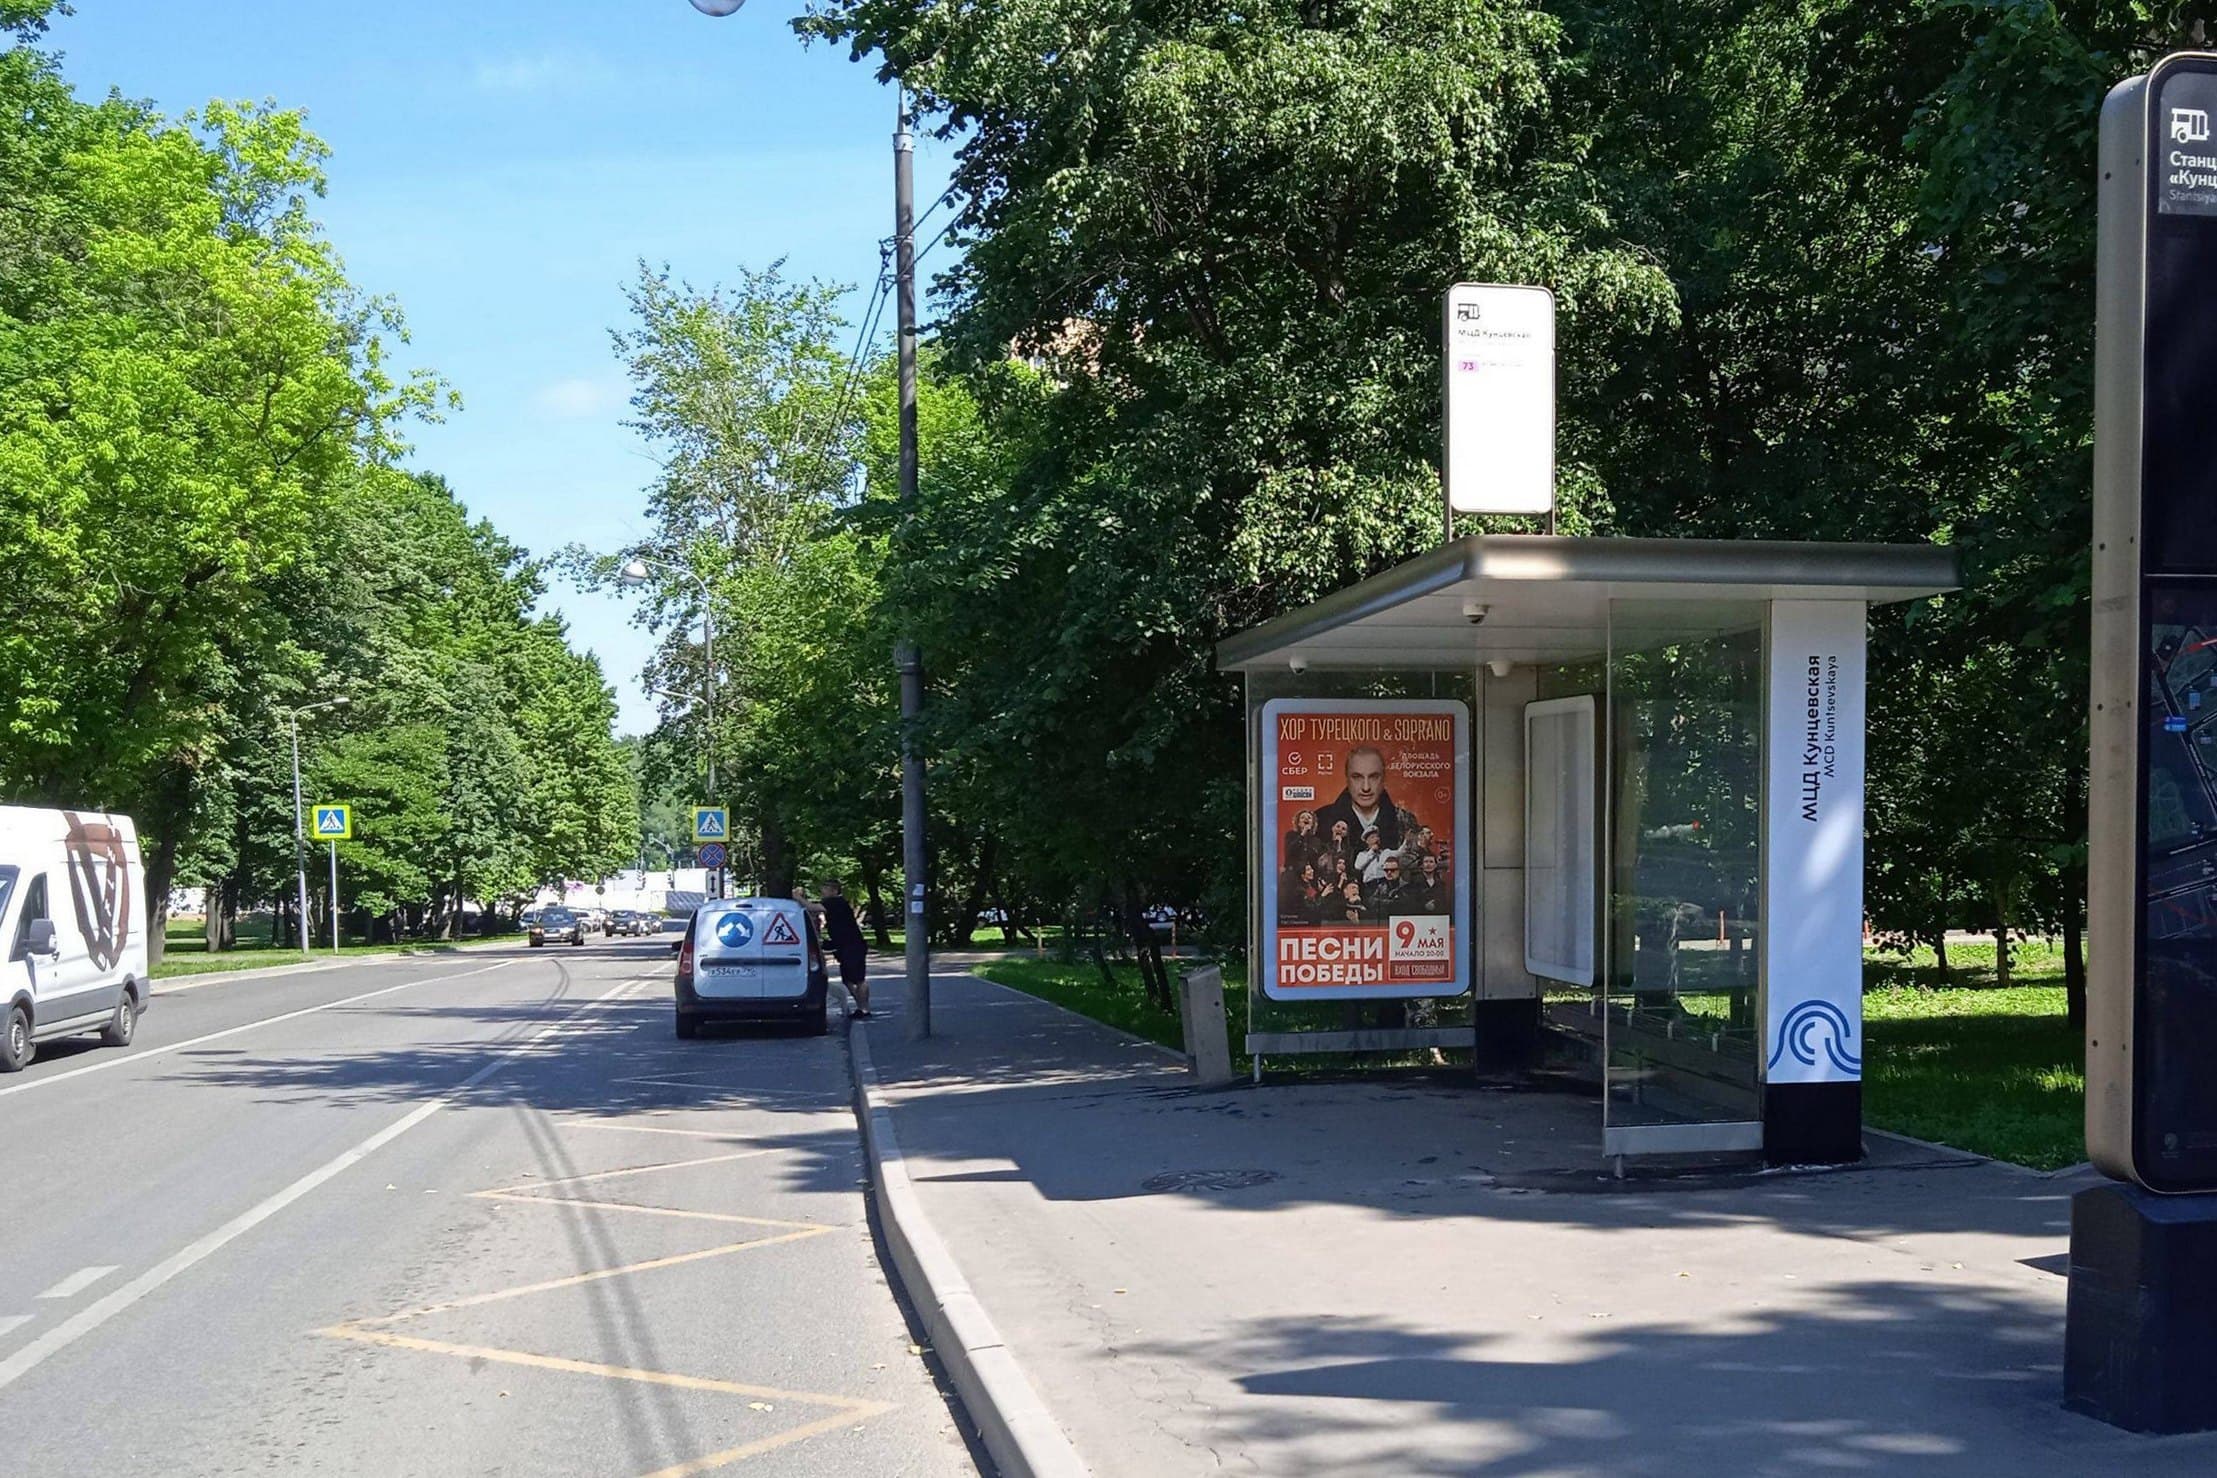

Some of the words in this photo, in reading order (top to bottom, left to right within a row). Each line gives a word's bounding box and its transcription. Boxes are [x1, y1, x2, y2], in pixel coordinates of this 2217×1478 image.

[2170, 151, 2217, 171] Станц
[2170, 169, 2217, 189] «Кунц
[1462, 361, 1474, 371] 73
[1803, 655, 1822, 765] Кунцевская
[1825, 655, 1839, 742] Kuntsevskaya
[1280, 718, 1306, 741] ХОР
[1310, 718, 1380, 743] ТУРЕЦКОГО
[1383, 728, 1393, 741] &
[1394, 718, 1450, 741] SOPRANO
[1282, 767, 1308, 775] СБЕР
[1824, 745, 1835, 778] MCD
[1802, 771, 1821, 822] МЦД
[1396, 920, 1416, 949] 9
[1417, 938, 1445, 948] МАЯ
[1280, 937, 1383, 960] ПЕСНИ
[1280, 963, 1383, 985] ПОБЕДЫ
